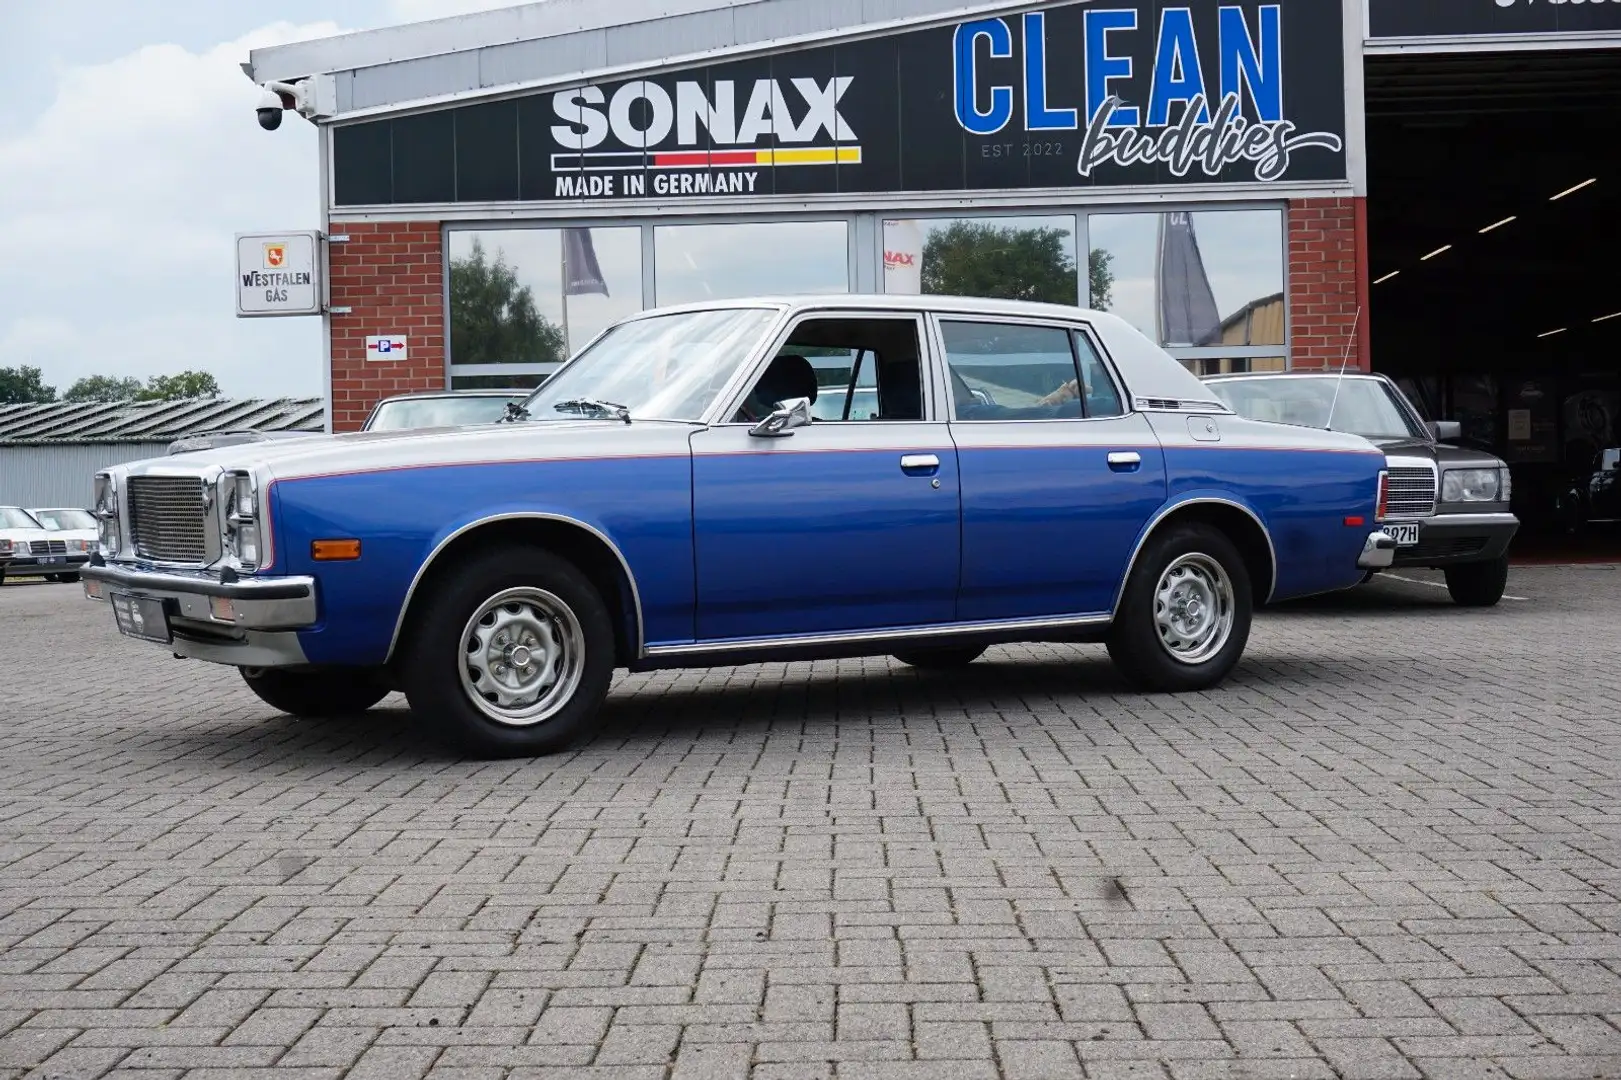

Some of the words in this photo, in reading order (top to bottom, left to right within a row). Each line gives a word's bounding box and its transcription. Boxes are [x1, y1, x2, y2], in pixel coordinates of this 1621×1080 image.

[953, 5, 1283, 134] CLEAN
[550, 76, 858, 149] SONAX
[1078, 91, 1342, 181] buddies
[980, 143, 1014, 158] EST
[1022, 142, 1064, 157] 2022
[554, 175, 613, 196] MADE
[623, 174, 645, 195] IN
[654, 173, 758, 196] GERMANY
[243, 271, 311, 287] WESTFALEN
[265, 288, 288, 302] GAS
